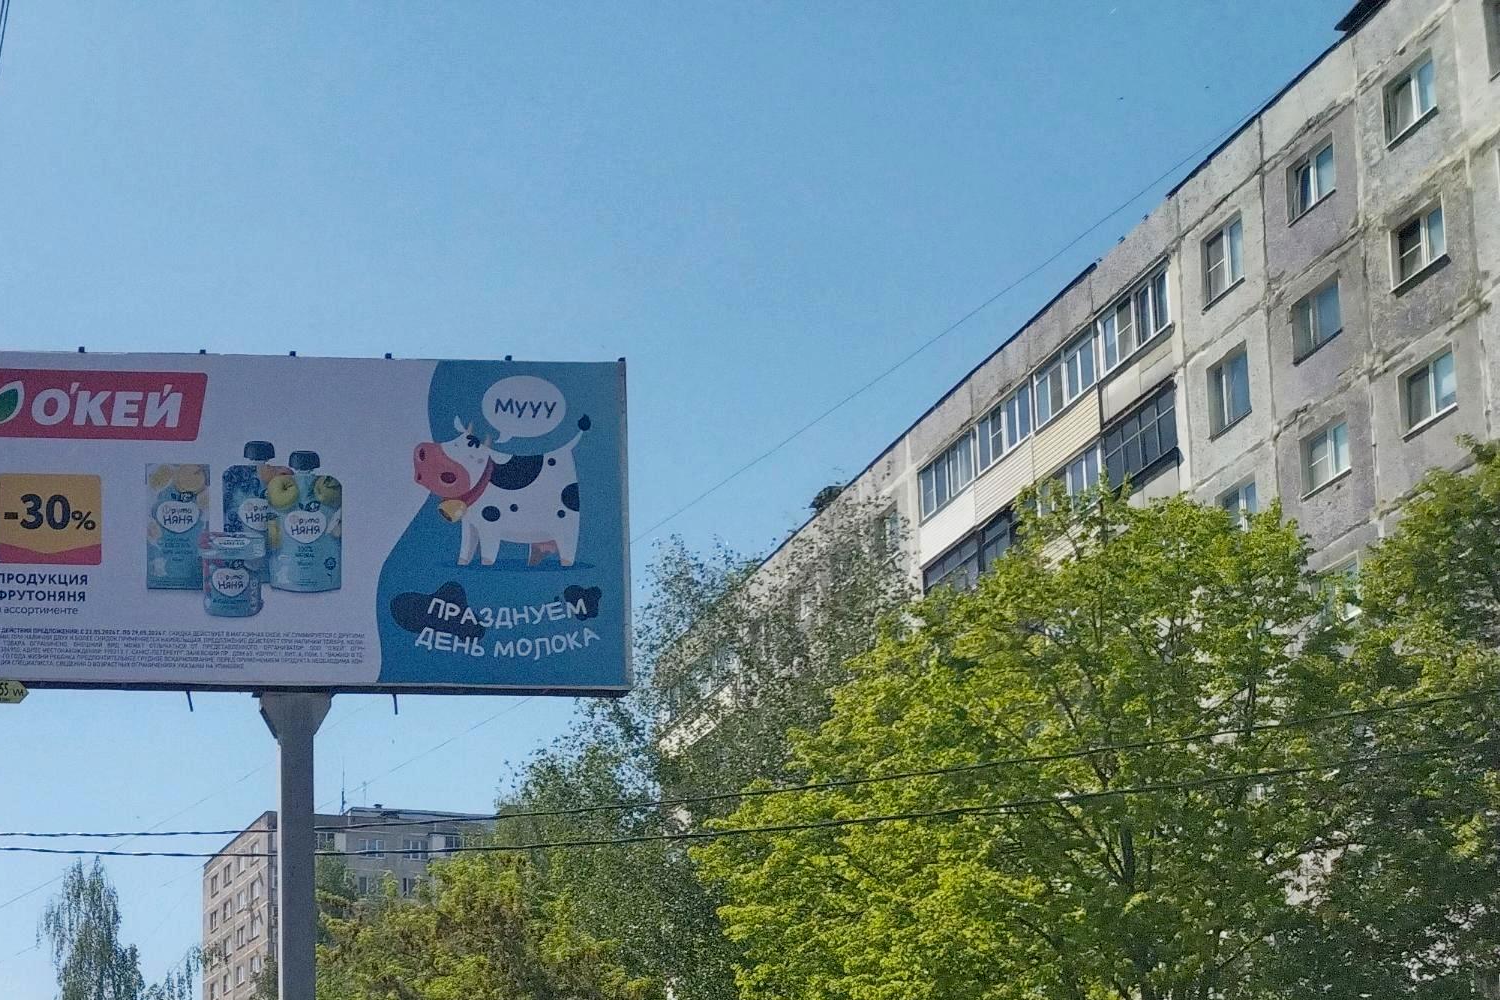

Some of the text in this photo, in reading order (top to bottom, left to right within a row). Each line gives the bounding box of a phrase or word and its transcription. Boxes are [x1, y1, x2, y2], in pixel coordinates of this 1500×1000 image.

[31, 382, 183, 428] О'КЕЙ
[3, 493, 96, 531] -30%
[3, 606, 79, 616] ассортименте
[427, 597, 588, 630] ПРАЗДНУЕМ
[415, 627, 601, 661] ДЕНЬ МОЛОКА
